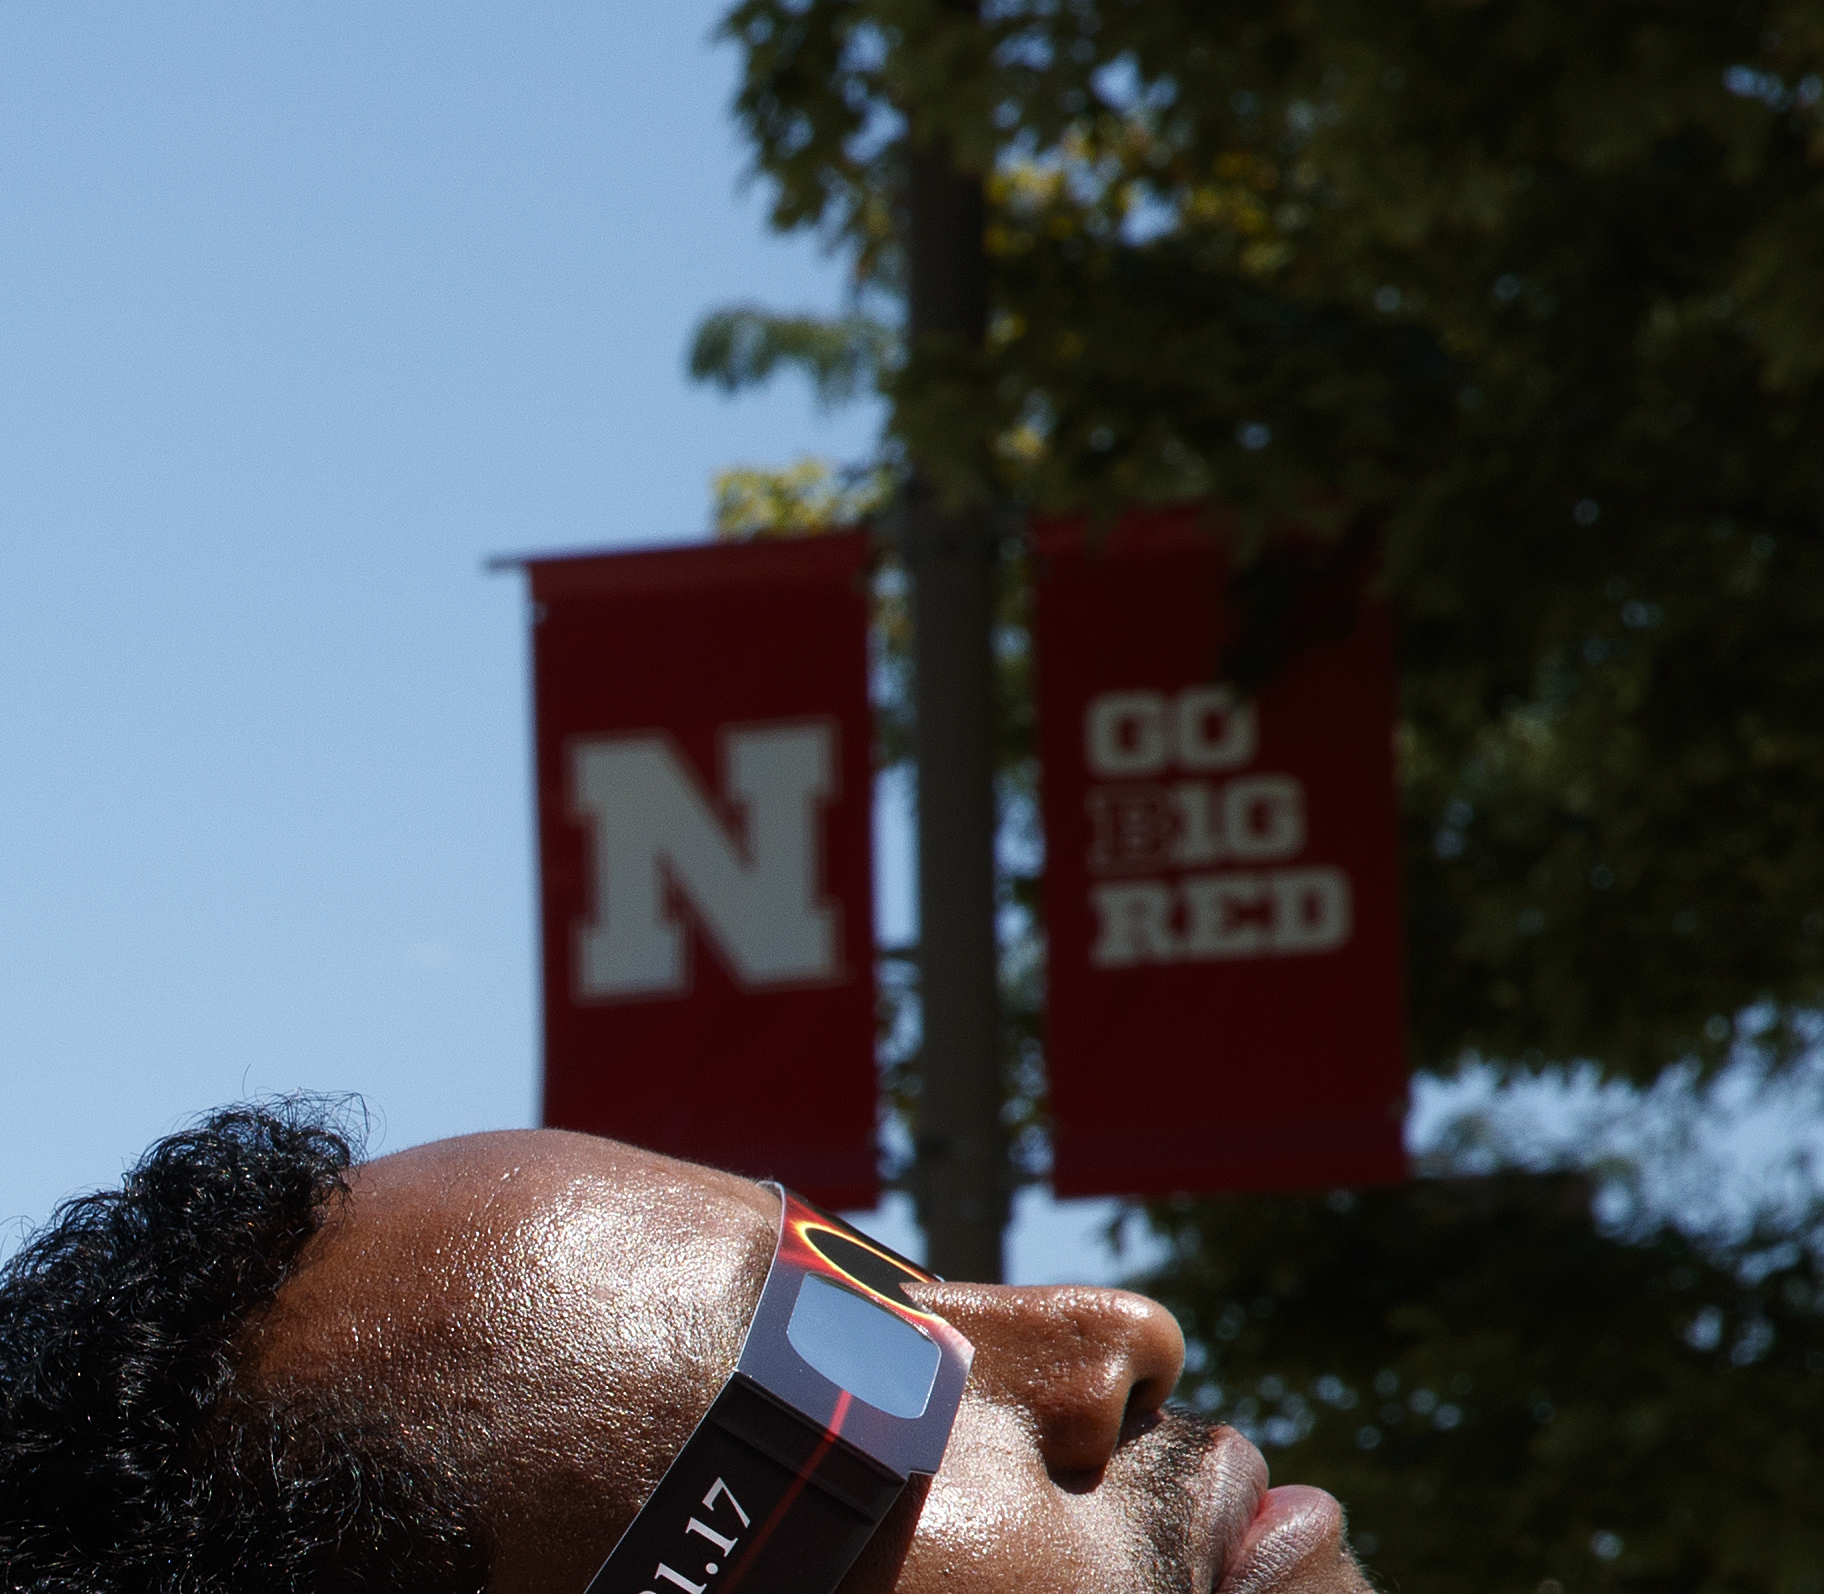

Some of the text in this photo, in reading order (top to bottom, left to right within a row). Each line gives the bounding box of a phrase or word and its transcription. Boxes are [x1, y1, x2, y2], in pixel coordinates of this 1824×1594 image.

[1082, 683, 1259, 777] GO
[563, 716, 845, 1006] N
[1087, 864, 1354, 970] RED
